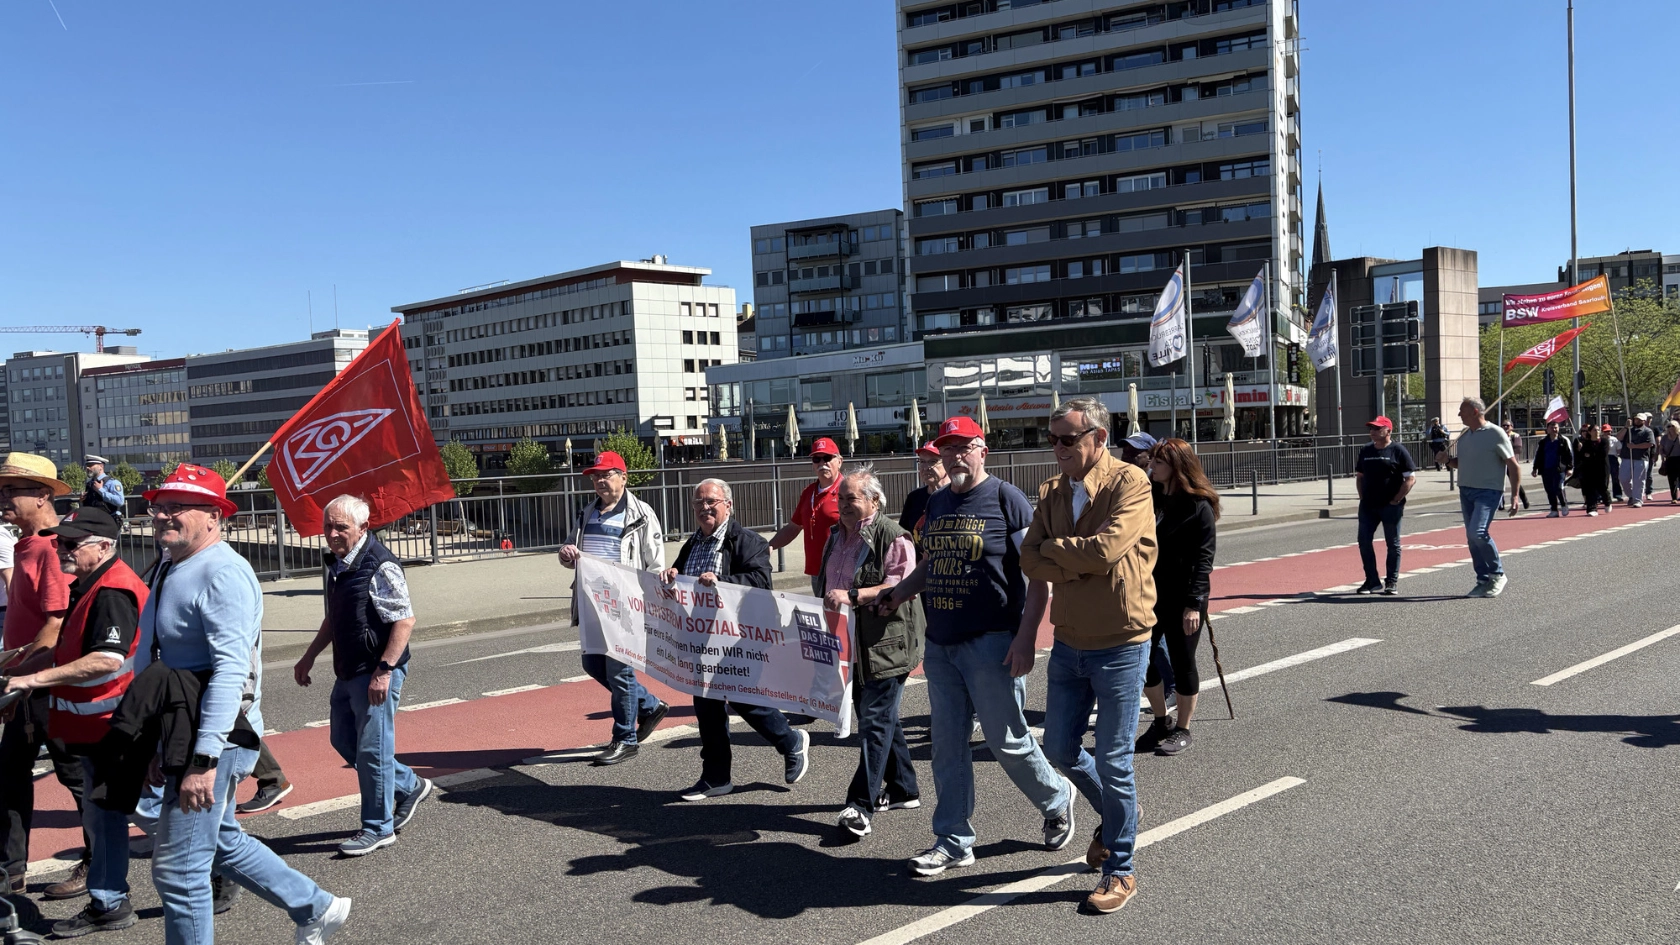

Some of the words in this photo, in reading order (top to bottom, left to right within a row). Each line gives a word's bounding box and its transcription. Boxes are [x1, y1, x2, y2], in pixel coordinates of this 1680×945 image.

[1506, 306, 1539, 320] BSW
[1541, 301, 1578, 313] Kreisverband
[954, 519, 986, 531] ROUGH
[923, 535, 984, 561] GLENWOOD
[932, 558, 963, 576] TOURS
[945, 578, 978, 587] PIONEERS
[945, 587, 954, 595] THE
[690, 590, 724, 609] WEG
[932, 597, 954, 610] 1956
[627, 596, 646, 613] VON
[686, 618, 785, 646] SOZIALSTAAT!
[797, 613, 819, 627] WEIL
[801, 630, 818, 643] DAS
[819, 634, 841, 650] JETZT
[656, 645, 665, 657] ein
[677, 656, 694, 673] lang
[696, 663, 750, 677] gearbeitet!
[689, 641, 720, 656] haben
[722, 646, 744, 659] WIR
[746, 648, 770, 663] nicht
[803, 645, 831, 663] ZÄHLT.
[615, 644, 625, 655] Eine
[625, 648, 636, 659] Aktion
[675, 673, 685, 683] der
[737, 684, 797, 702] Geschäftsstellen
[798, 695, 808, 705] der
[809, 697, 817, 707] IG
